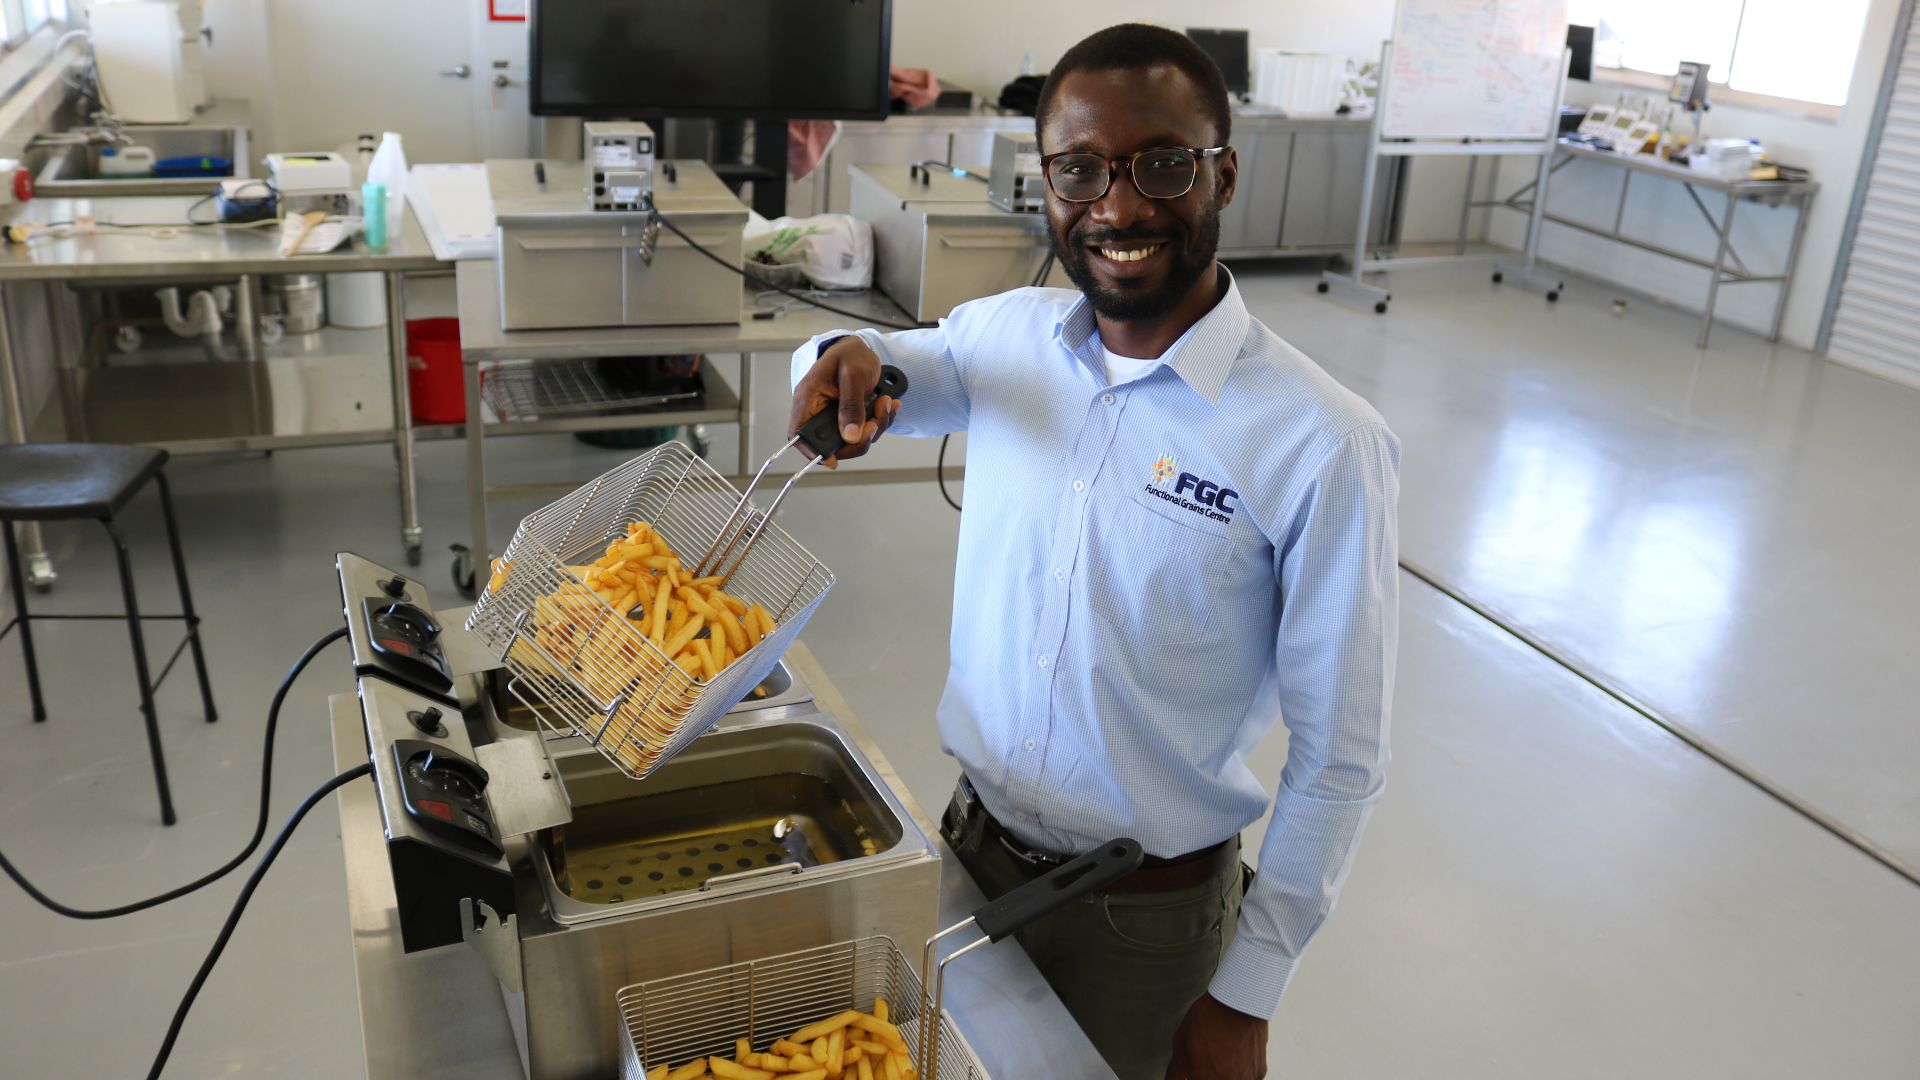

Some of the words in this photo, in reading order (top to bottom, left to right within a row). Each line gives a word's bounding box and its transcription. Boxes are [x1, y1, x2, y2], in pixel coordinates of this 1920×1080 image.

[1145, 484, 1181, 505] Functional
[1181, 499, 1205, 515] Grains
[1205, 509, 1231, 524] Centre
[1175, 472, 1239, 514] FGC
